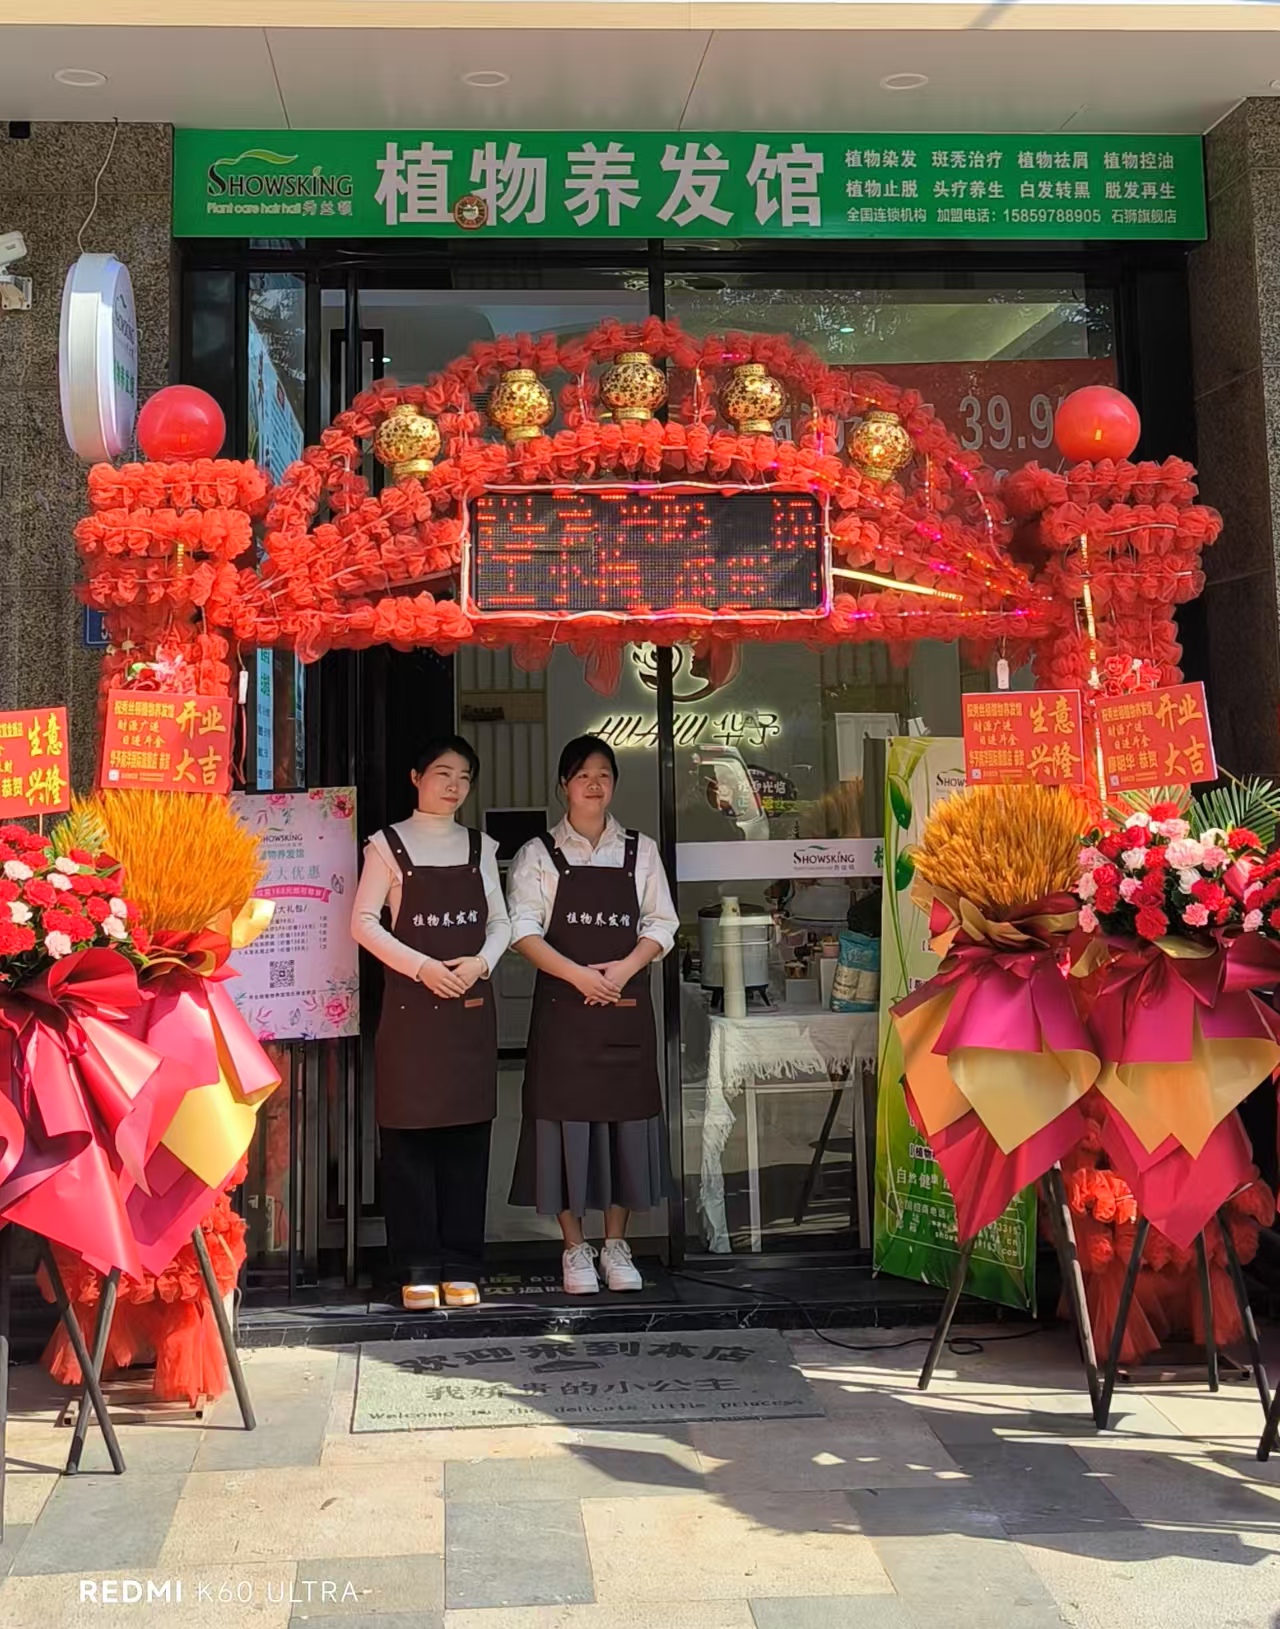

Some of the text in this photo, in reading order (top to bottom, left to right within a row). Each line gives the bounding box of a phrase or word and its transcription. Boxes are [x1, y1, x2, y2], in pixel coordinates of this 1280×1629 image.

[845, 149, 1175, 170] 植物染发 斑秃治疗 植物祛屑 植物控油
[374, 142, 824, 227] 植物养发馆
[846, 179, 1177, 200] 植物止脱 头疗养生 白发转黑 脱发再生
[847, 207, 927, 223] 全国连锁机构
[1111, 208, 1177, 224] 石狮旗舰店
[959, 394, 1064, 450] 39.9
[176, 700, 227, 740] 开业
[1029, 696, 1076, 735] 生意
[1155, 693, 1204, 732] 开业
[28, 712, 63, 757] 生意
[173, 746, 222, 786] 大吉
[1027, 741, 1080, 780] 兴隆
[1165, 736, 1206, 778] 大吉
[261, 833, 304, 843] HOWSKING
[412, 910, 479, 928] 植物养发馆
[566, 911, 632, 928] 植物养发馆
[393, 1341, 756, 1374] 欢迎来到本店
